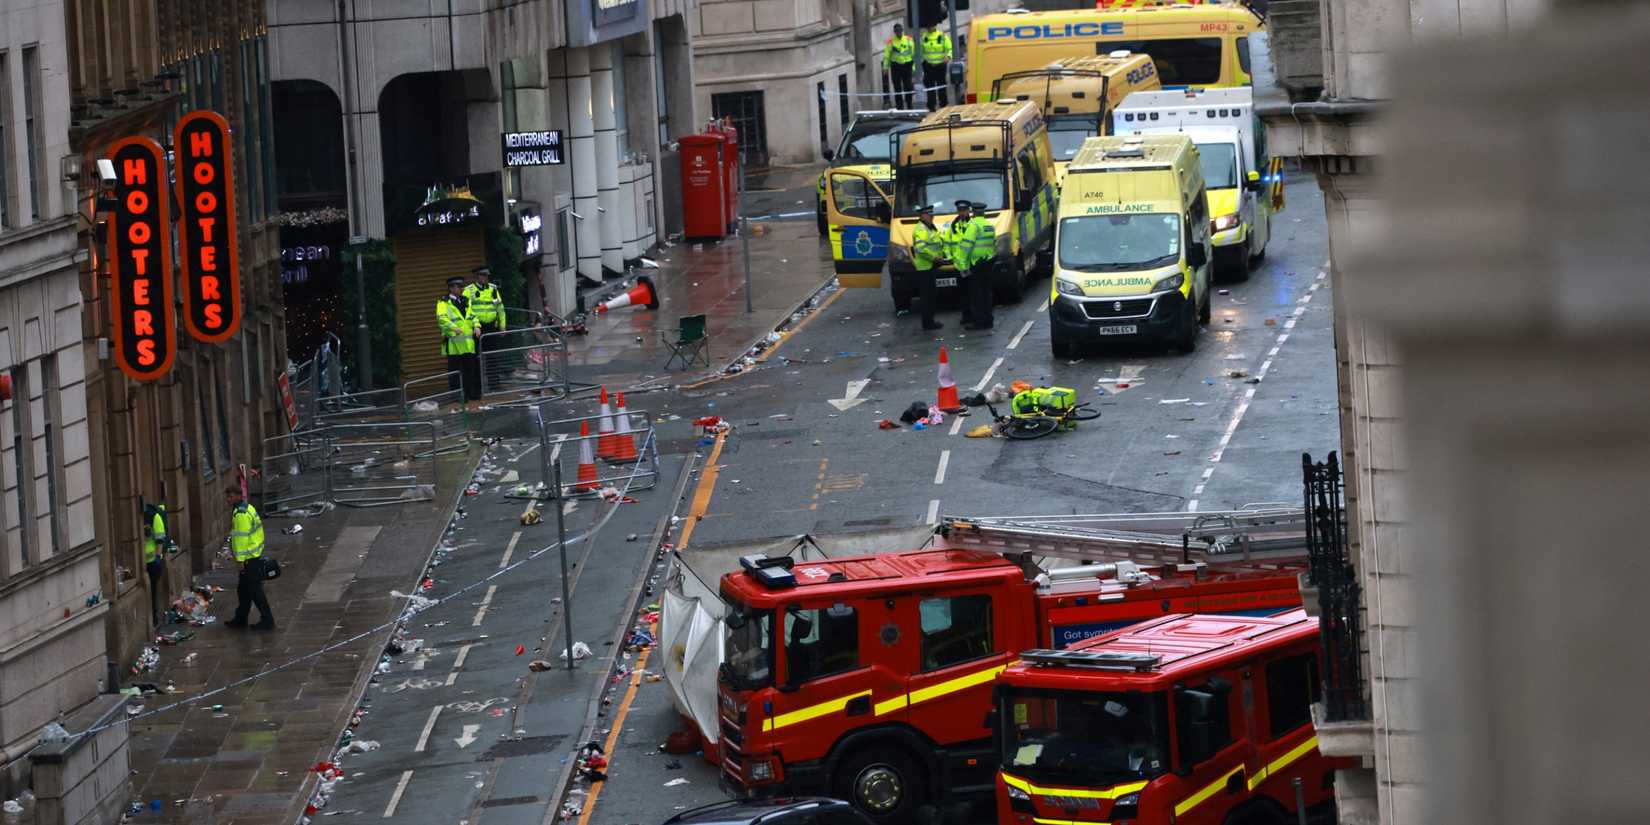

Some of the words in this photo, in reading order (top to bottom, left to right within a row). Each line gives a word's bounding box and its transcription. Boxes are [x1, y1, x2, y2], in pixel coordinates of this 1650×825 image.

[988, 21, 1124, 41] POLICE
[1200, 23, 1228, 33] MP43
[1126, 62, 1153, 85] POLICE
[505, 131, 559, 147] MEDITERRANEAN
[507, 152, 541, 165] CHARCOAL
[542, 150, 560, 163] GRILL
[1086, 204, 1154, 214] AMBULANCE
[191, 131, 223, 329] HOOTERS
[123, 158, 156, 366] HOOTERS
[1064, 630, 1082, 640] Got
